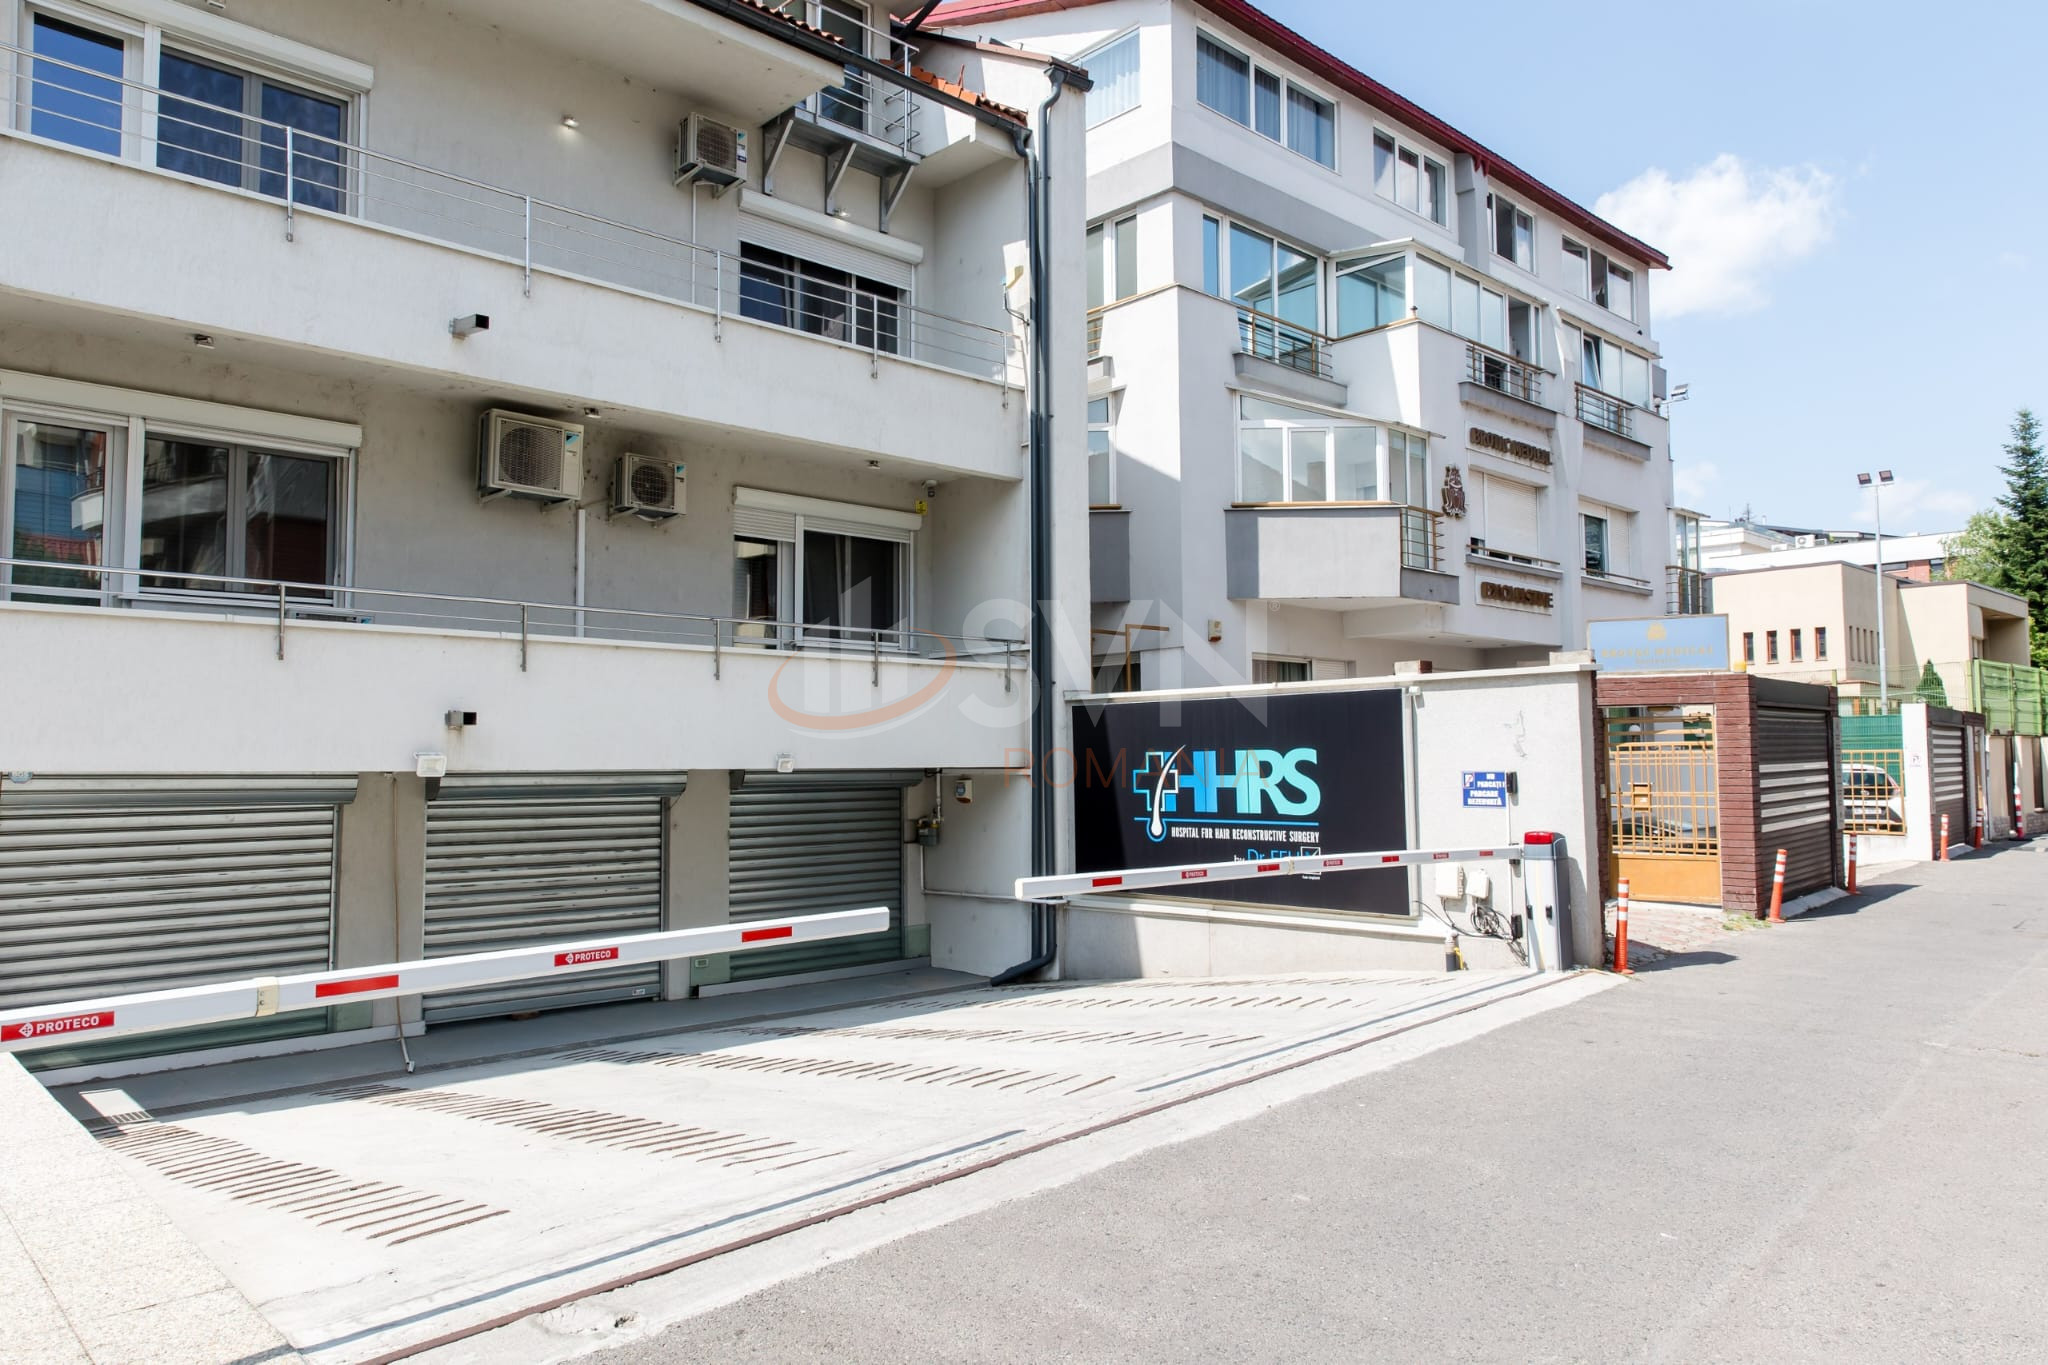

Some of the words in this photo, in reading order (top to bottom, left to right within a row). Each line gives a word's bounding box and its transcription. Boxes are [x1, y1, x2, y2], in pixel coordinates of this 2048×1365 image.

[1171, 827, 1199, 838] HOSPITAL
[1201, 828, 1213, 839] FOR
[1215, 828, 1230, 840] HAIR
[1232, 829, 1287, 841] RECONSTRUCTIVE
[1289, 831, 1320, 843] SURGERY
[574, 950, 611, 962] PROTECO
[36, 1015, 100, 1034] PROTECO
